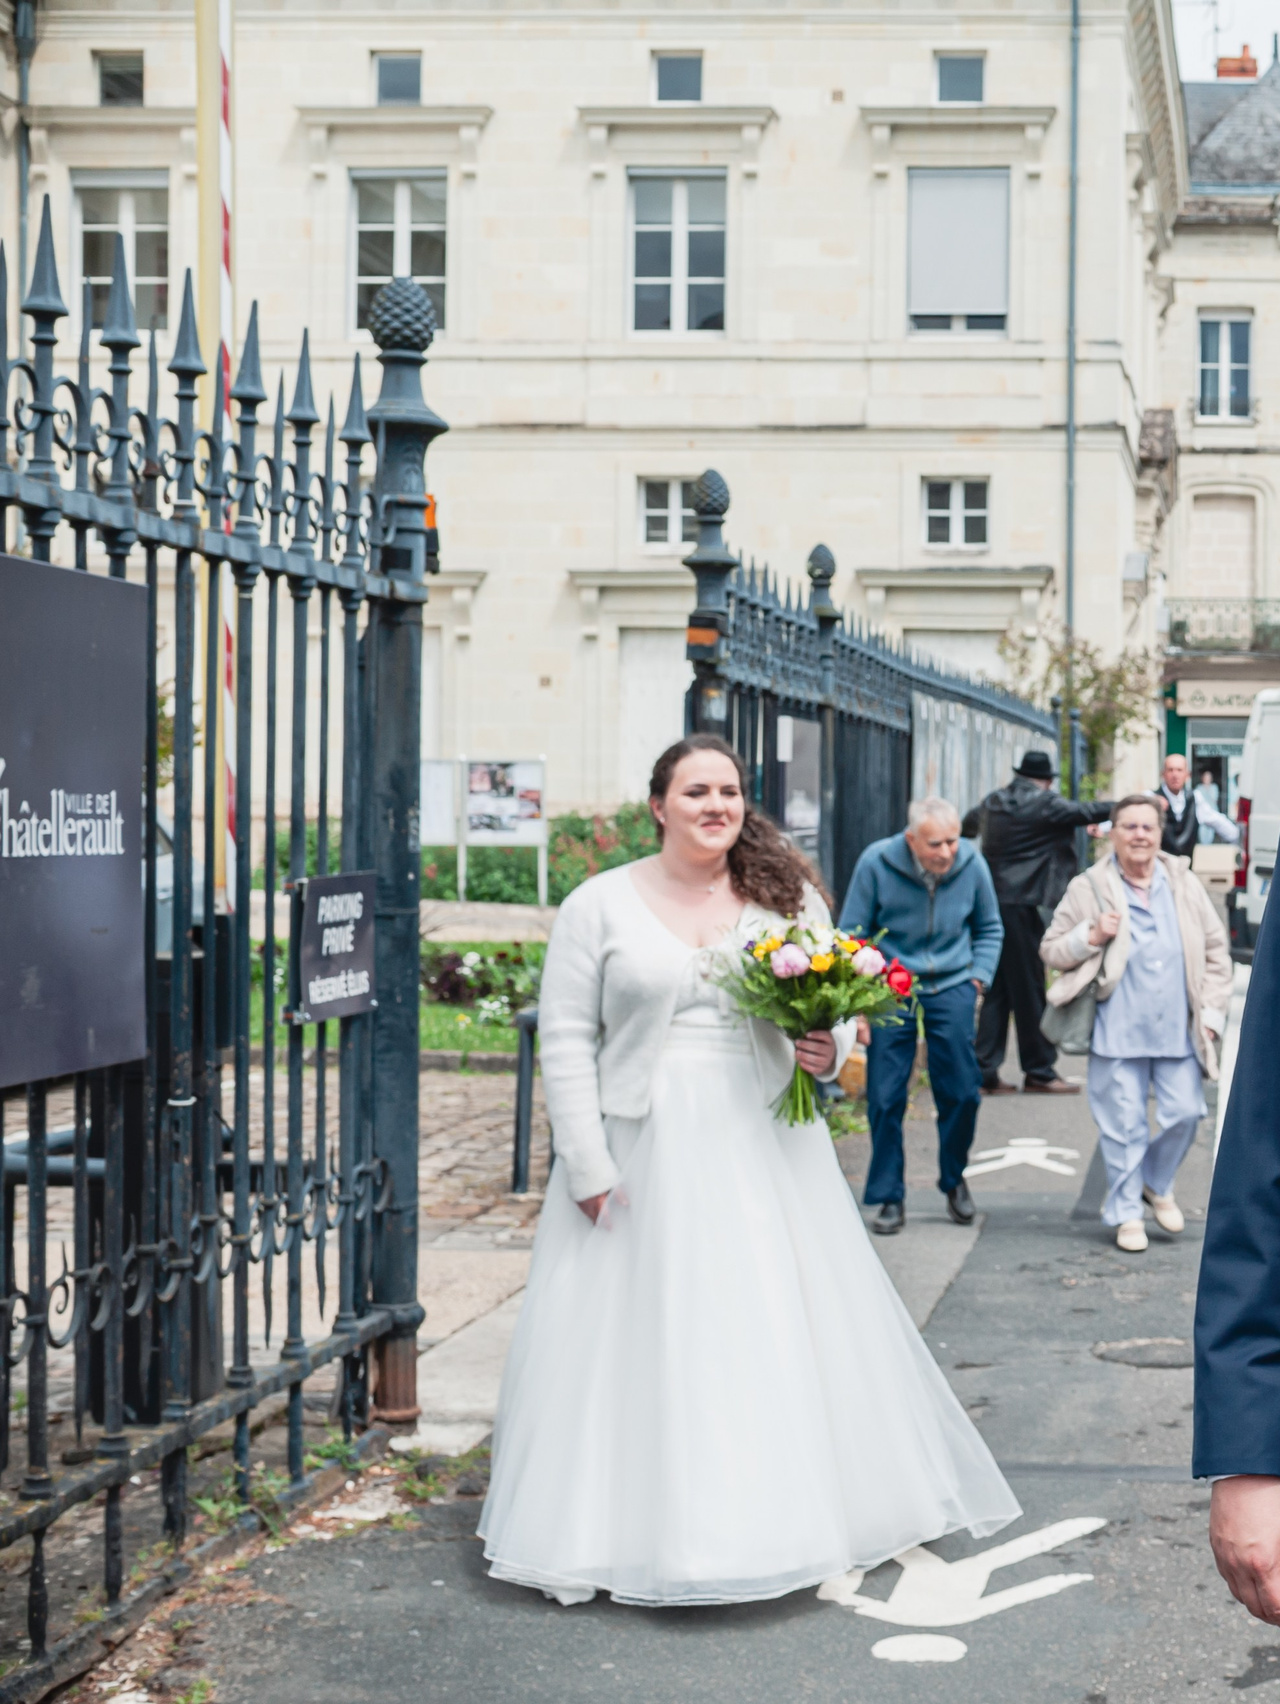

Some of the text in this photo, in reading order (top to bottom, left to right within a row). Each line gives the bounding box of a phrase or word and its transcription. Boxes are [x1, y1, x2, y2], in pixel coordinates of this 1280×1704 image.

[64, 792, 110, 816] VILLE DE
[0, 786, 126, 858] hâtellerault
[317, 891, 364, 925] PARKING
[322, 919, 356, 956] PRIVÉ
